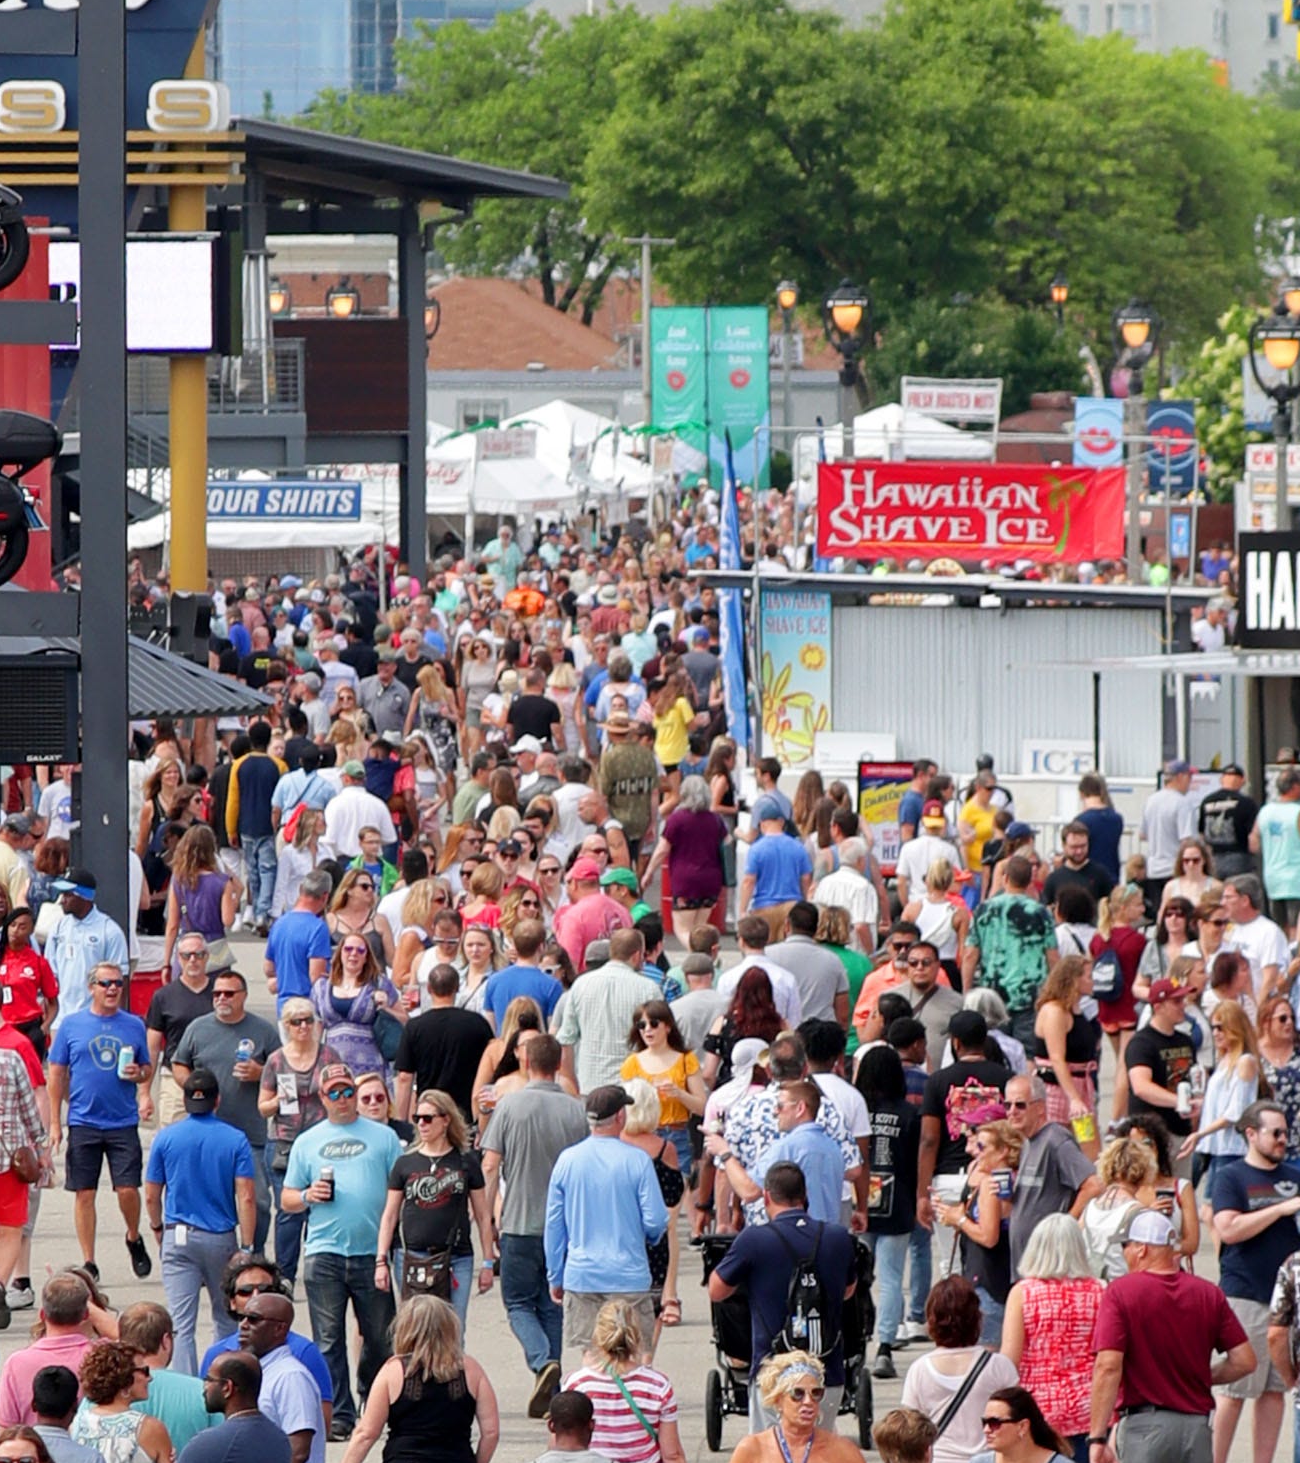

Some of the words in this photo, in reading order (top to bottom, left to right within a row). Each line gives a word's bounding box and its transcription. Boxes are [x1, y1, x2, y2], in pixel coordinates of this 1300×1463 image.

[206, 487, 260, 514] OUR
[264, 488, 355, 515] SHIRTS
[827, 505, 977, 548] SHAVE
[976, 508, 1055, 548] ICE
[323, 1142, 365, 1158] Vintage
